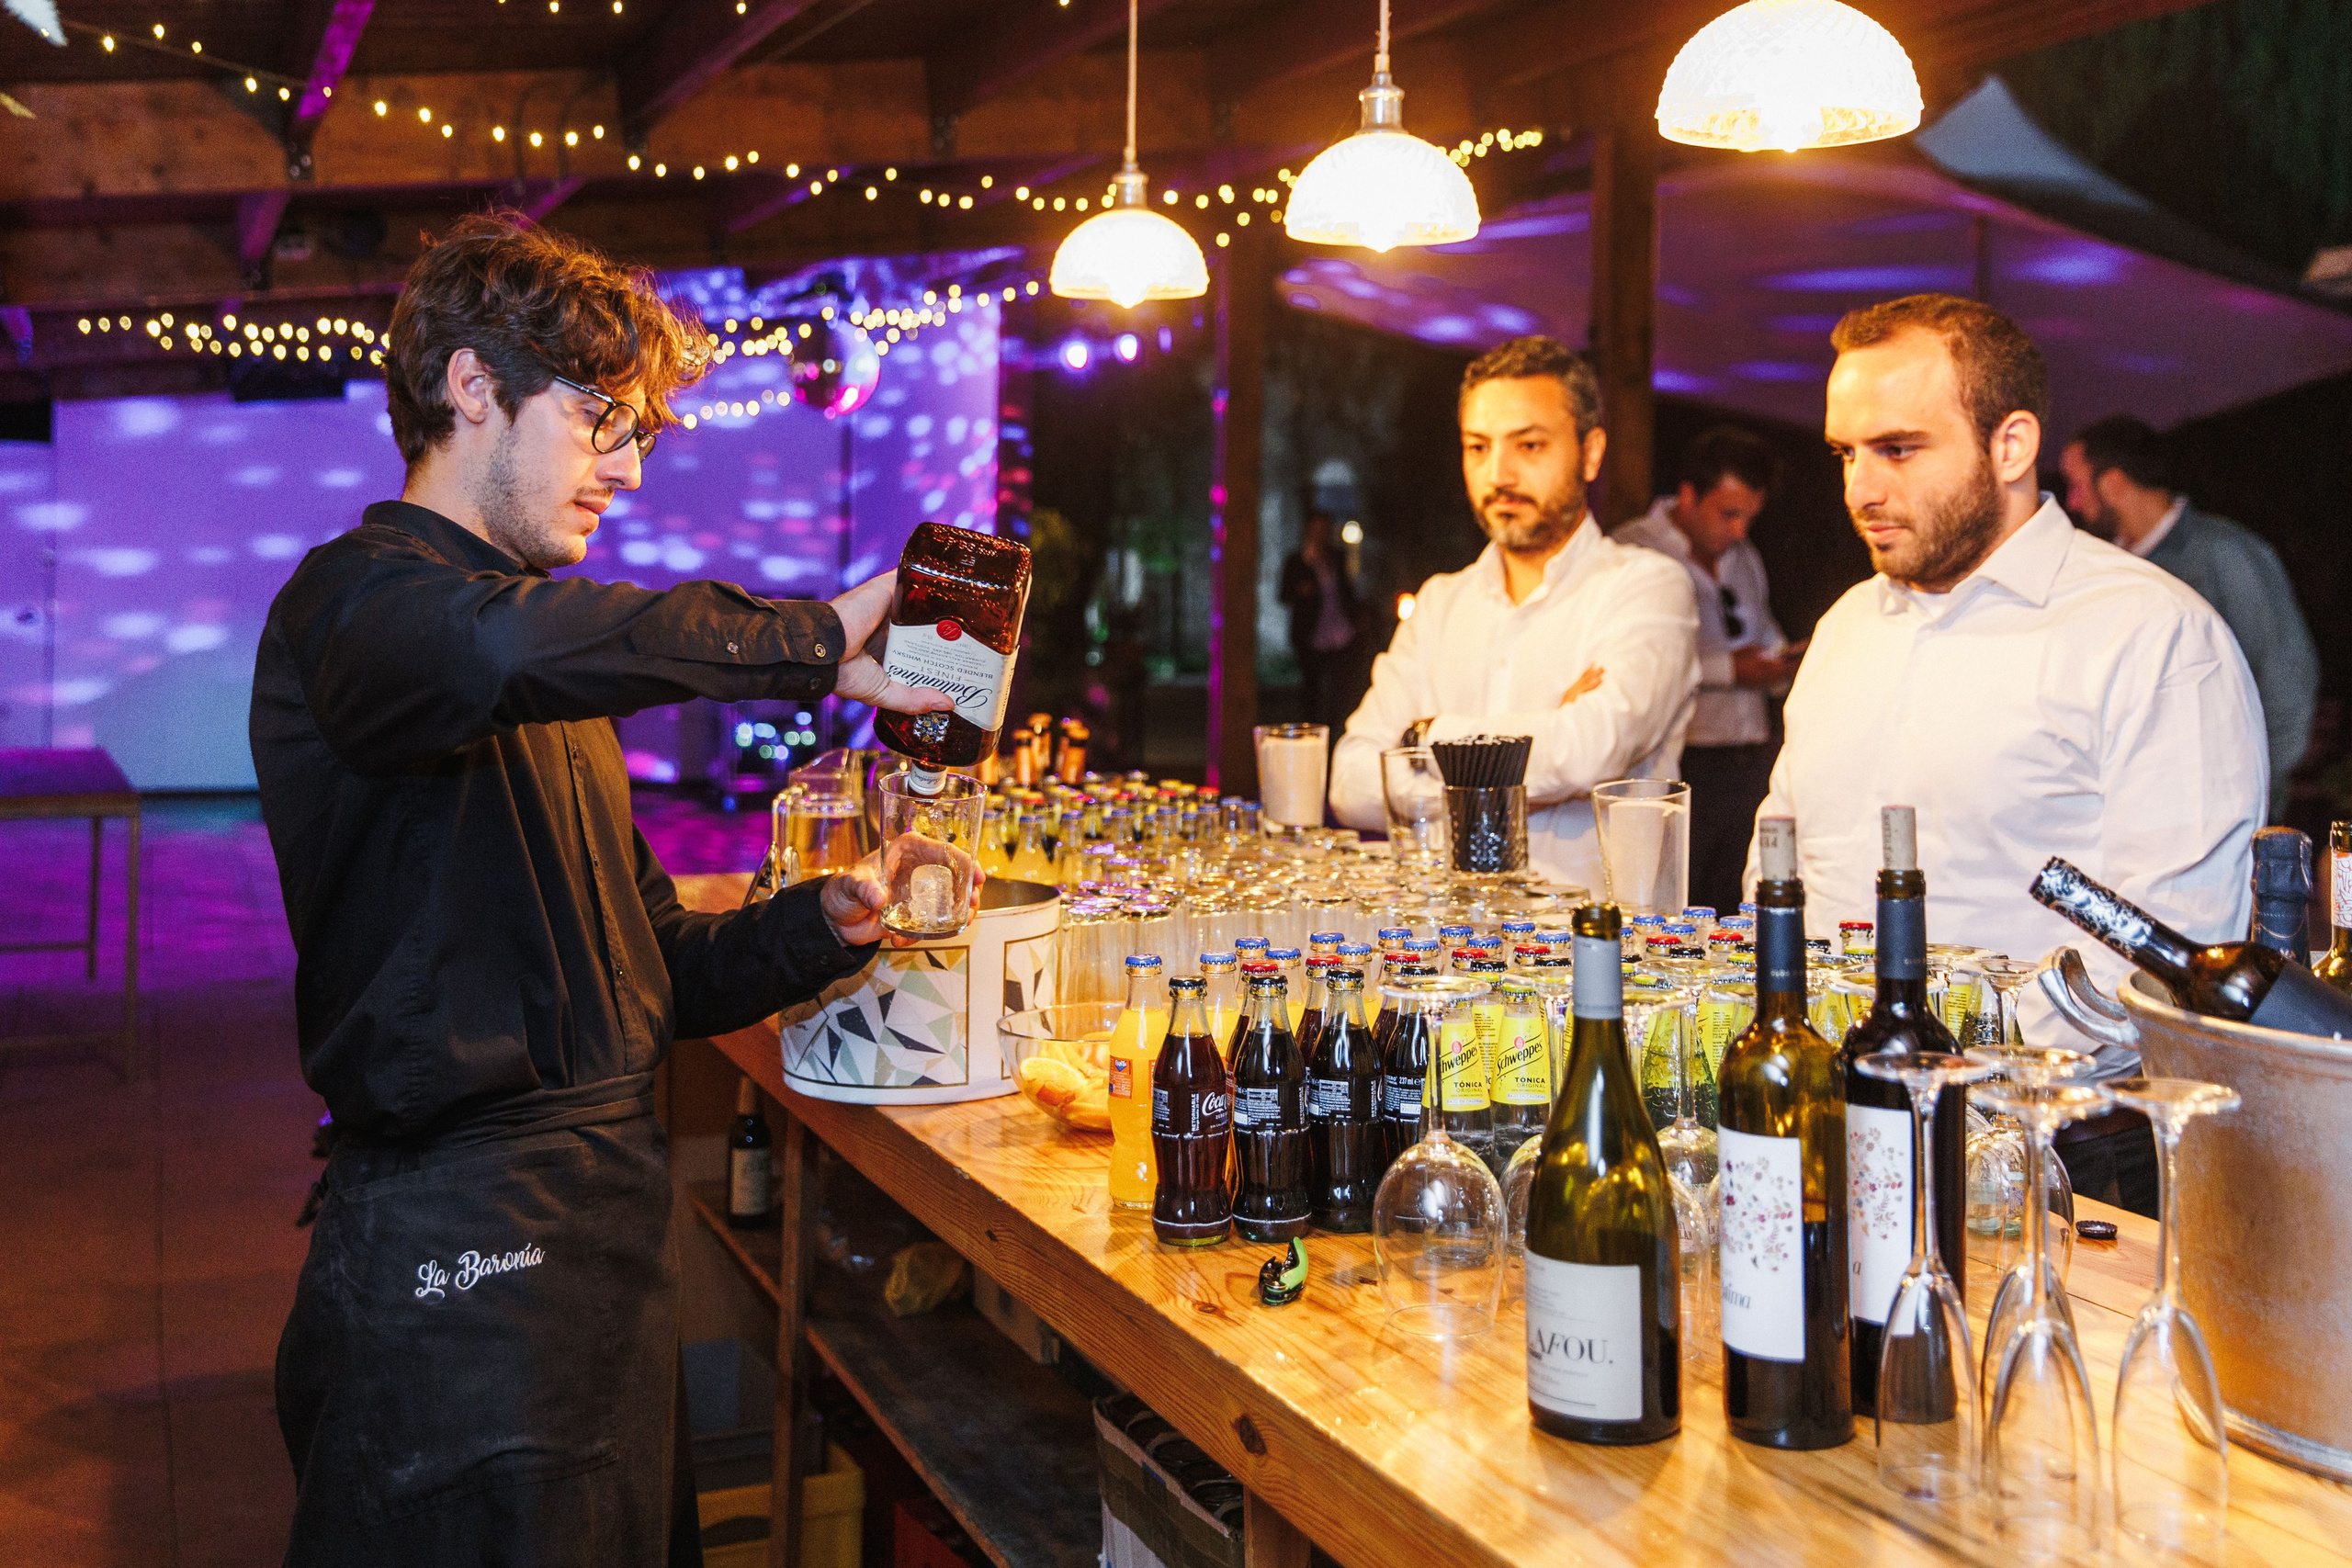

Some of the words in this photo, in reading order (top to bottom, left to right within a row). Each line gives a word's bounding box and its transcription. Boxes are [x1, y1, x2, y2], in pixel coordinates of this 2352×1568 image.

[892, 649, 921, 661] WHISKY
[923, 659, 954, 671] SCOTCH
[887, 665, 992, 708] Ballantine's
[920, 666, 961, 681] FINEST
[956, 667, 993, 679] BLENDED
[1442, 1044, 1478, 1073] hweppes
[1497, 1040, 1543, 1076] Schweppes
[415, 1259, 450, 1297] La
[455, 1243, 546, 1290] Baronía
[1532, 1327, 1613, 1364] AFOU.
